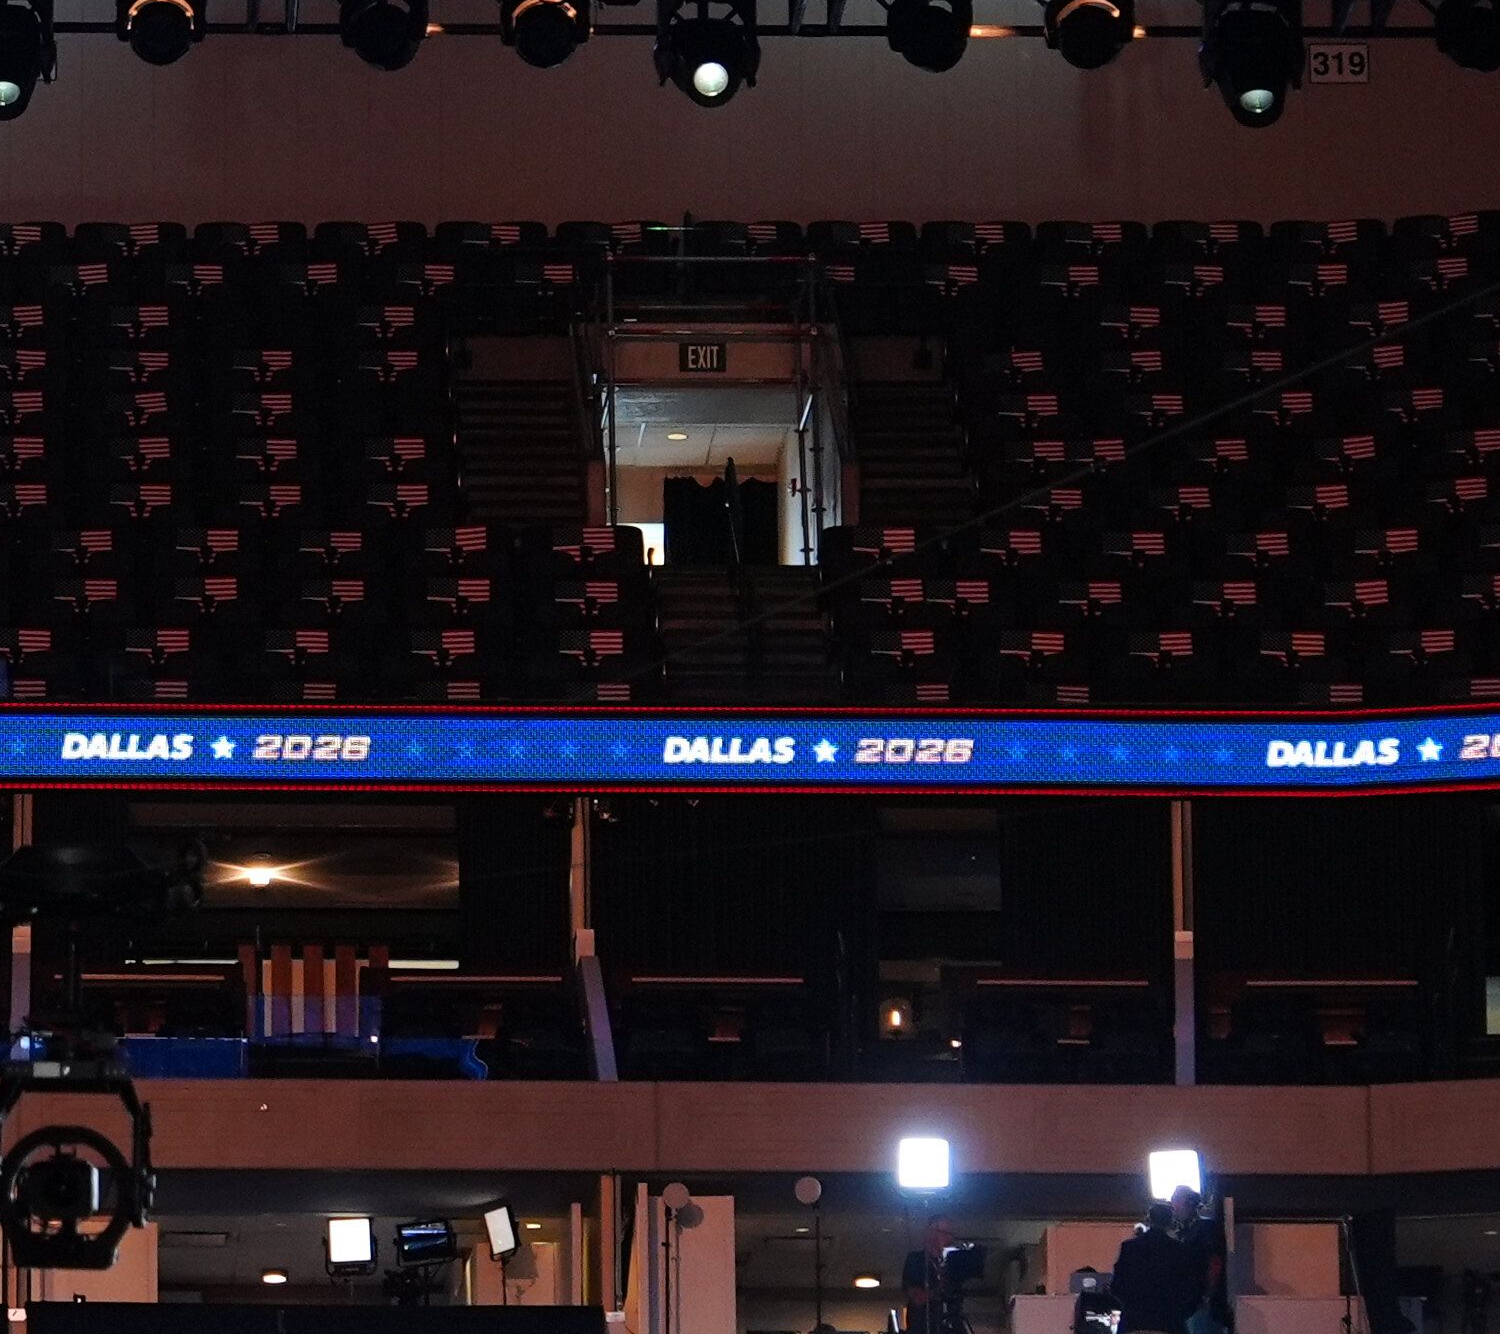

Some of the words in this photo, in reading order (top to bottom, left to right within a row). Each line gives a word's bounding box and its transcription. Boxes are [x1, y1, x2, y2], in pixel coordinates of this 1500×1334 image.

[1312, 51, 1366, 75] 319
[687, 345, 719, 369] EXIT
[62, 733, 193, 760] DALLAS
[253, 734, 371, 760] 2026
[664, 737, 795, 763] DALLAS
[856, 738, 973, 763] 2026
[1267, 738, 1399, 767] DALLAS
